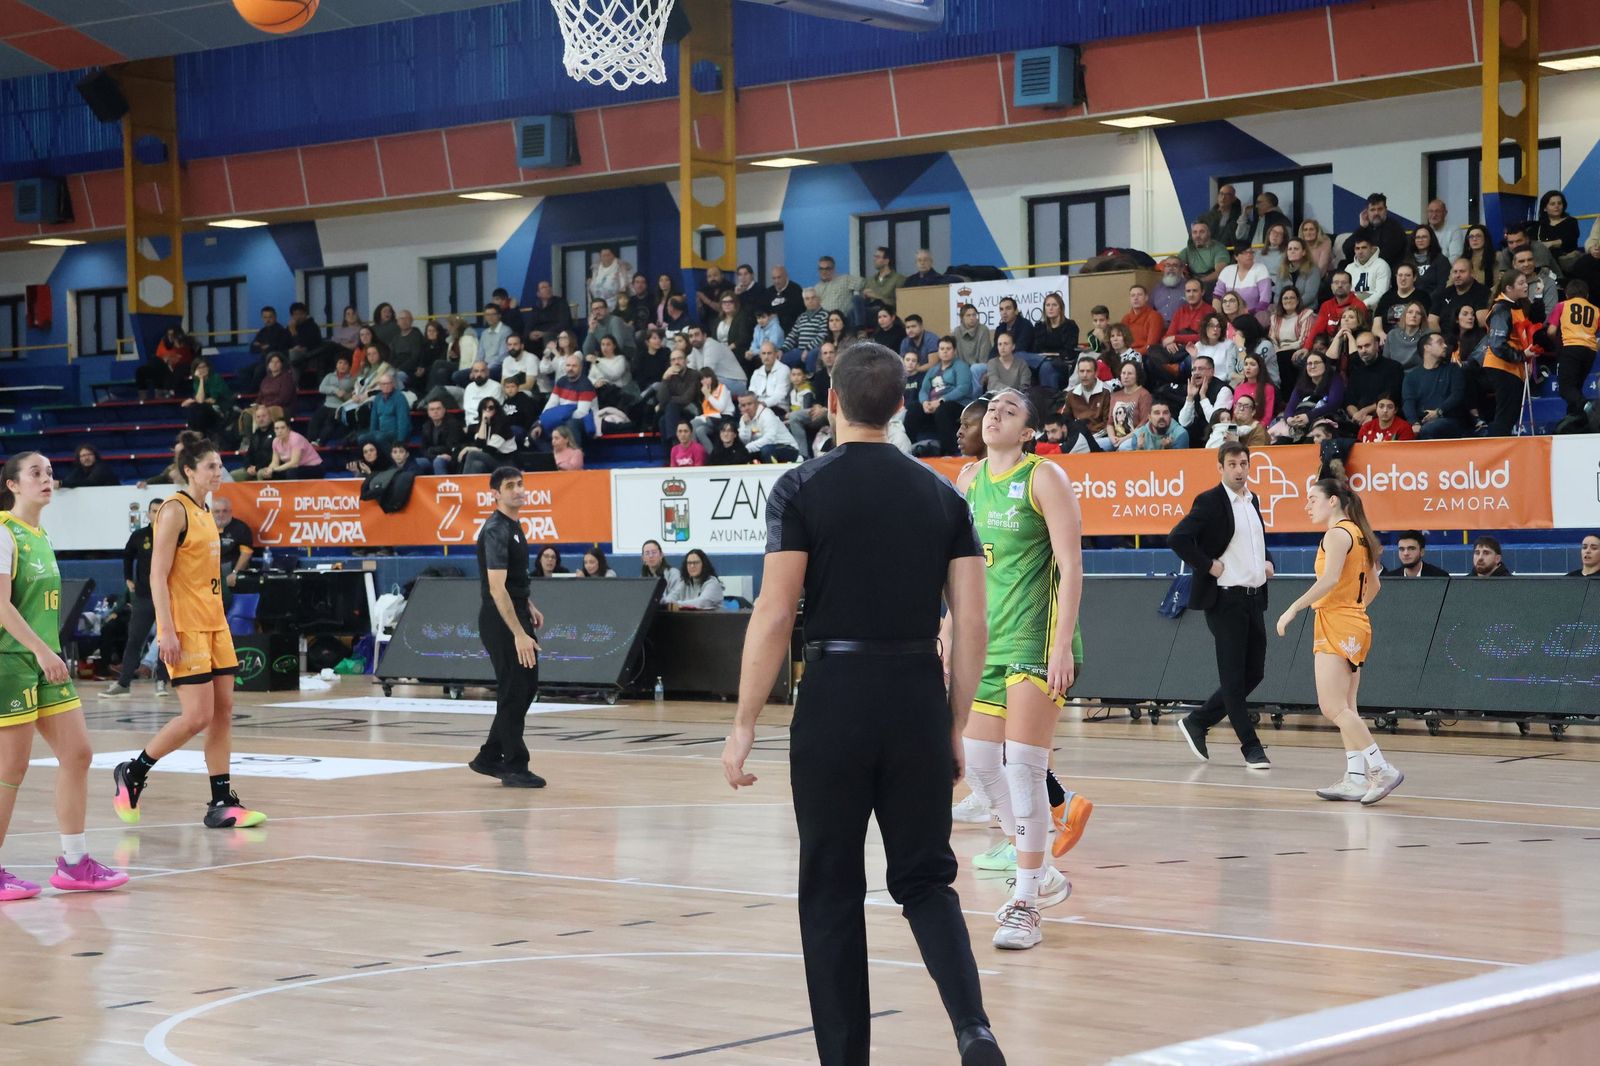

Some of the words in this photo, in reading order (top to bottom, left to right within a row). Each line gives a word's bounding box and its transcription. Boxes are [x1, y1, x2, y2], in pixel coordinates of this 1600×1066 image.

[1570, 303, 1594, 328] 80
[1125, 470, 1184, 498] salud
[1439, 460, 1510, 491] salud
[1112, 503, 1185, 517] ZAMORA
[1423, 497, 1509, 511] ZAMORA
[289, 521, 366, 544] ZAMORA
[987, 518, 1019, 529] enersun
[44, 589, 59, 610] 16
